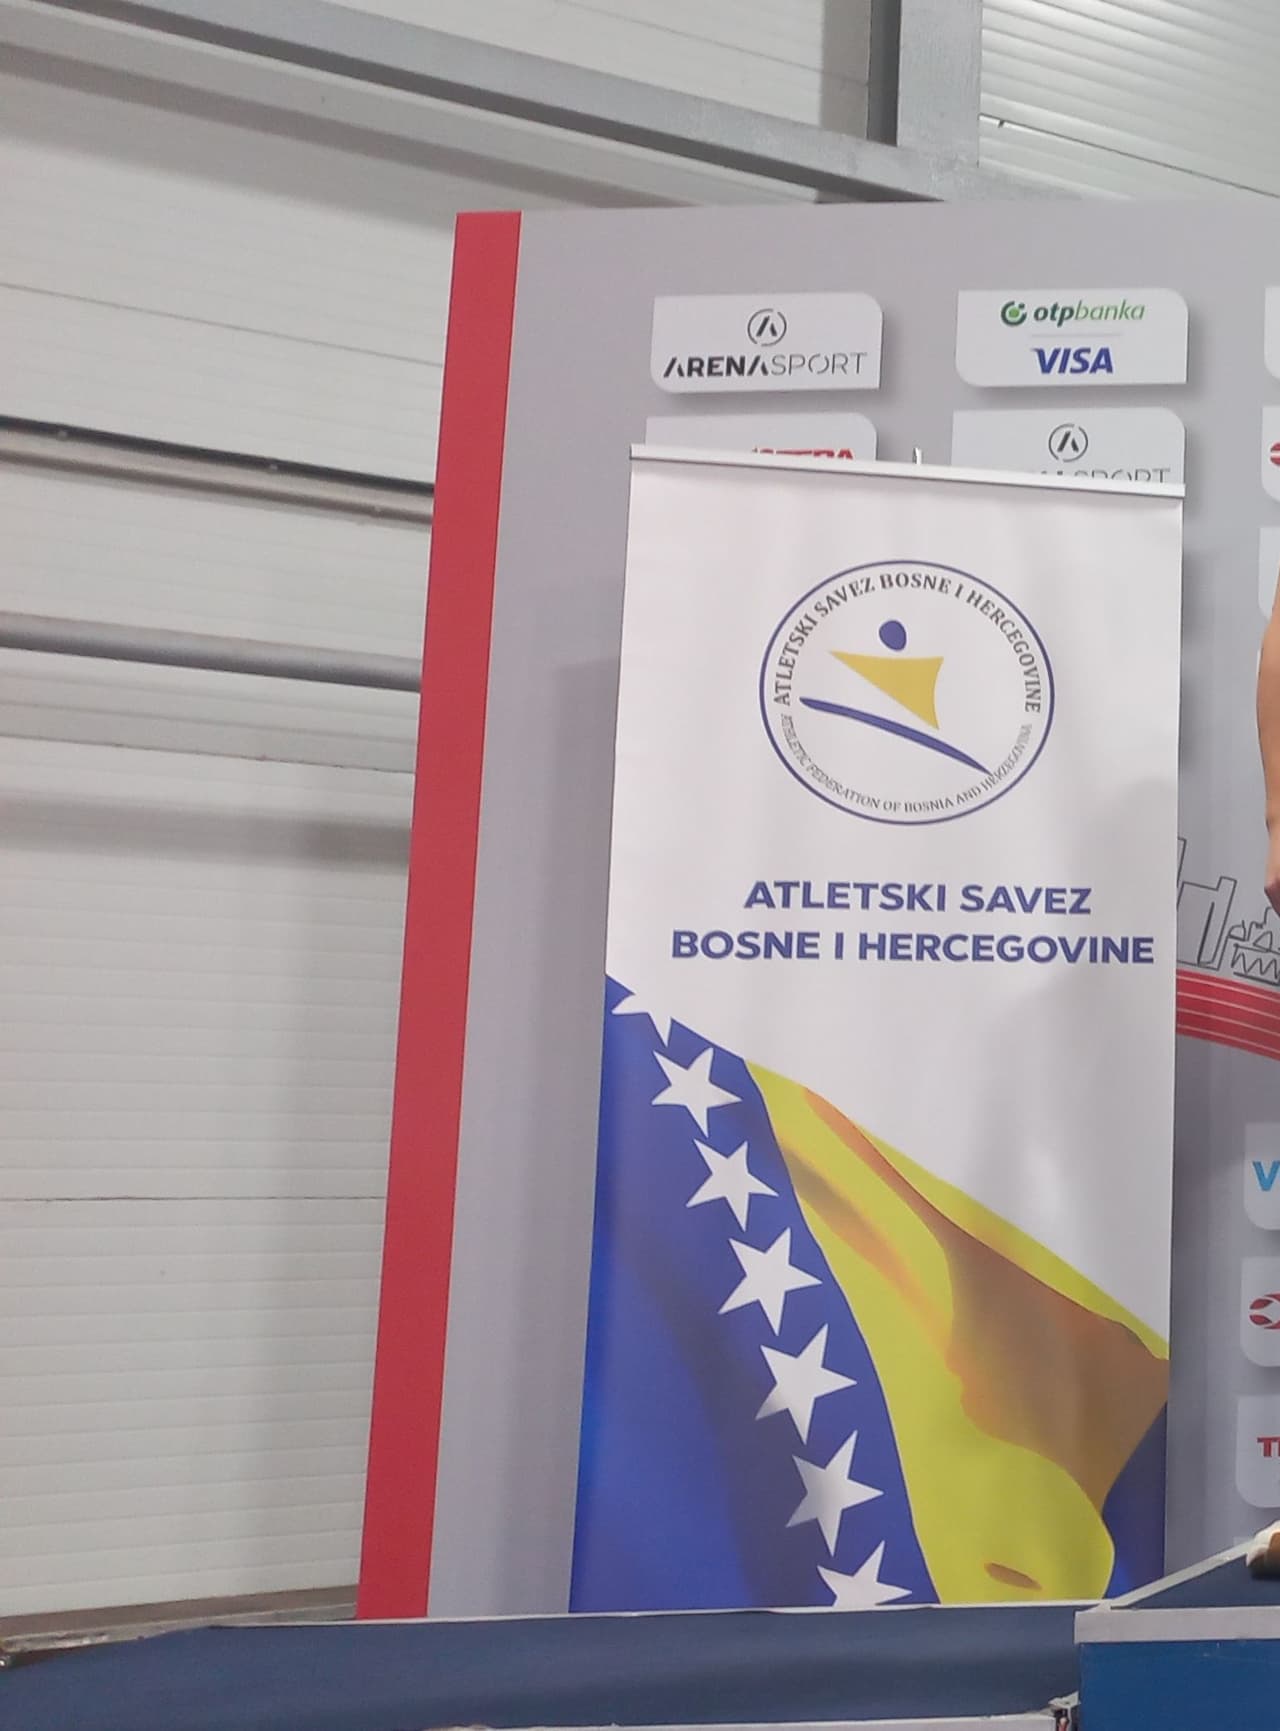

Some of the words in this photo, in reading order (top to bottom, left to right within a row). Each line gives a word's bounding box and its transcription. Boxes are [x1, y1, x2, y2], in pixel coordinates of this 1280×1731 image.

[1033, 299, 1146, 327] otpbanka
[663, 352, 868, 378] ARENASPORT
[1030, 347, 1115, 374] VISA
[773, 613, 819, 707] ATLETSKI
[814, 577, 876, 618] SAVEZ
[879, 572, 952, 596] BOSNE
[953, 583, 964, 599] I
[966, 590, 1041, 714] HERCEGOVINE
[744, 880, 946, 912] ATLETSKI
[959, 884, 1092, 915] SAVEZ
[672, 929, 820, 960] BOSNE
[834, 931, 845, 960] I
[858, 932, 1154, 964] HERCEGOVINE
